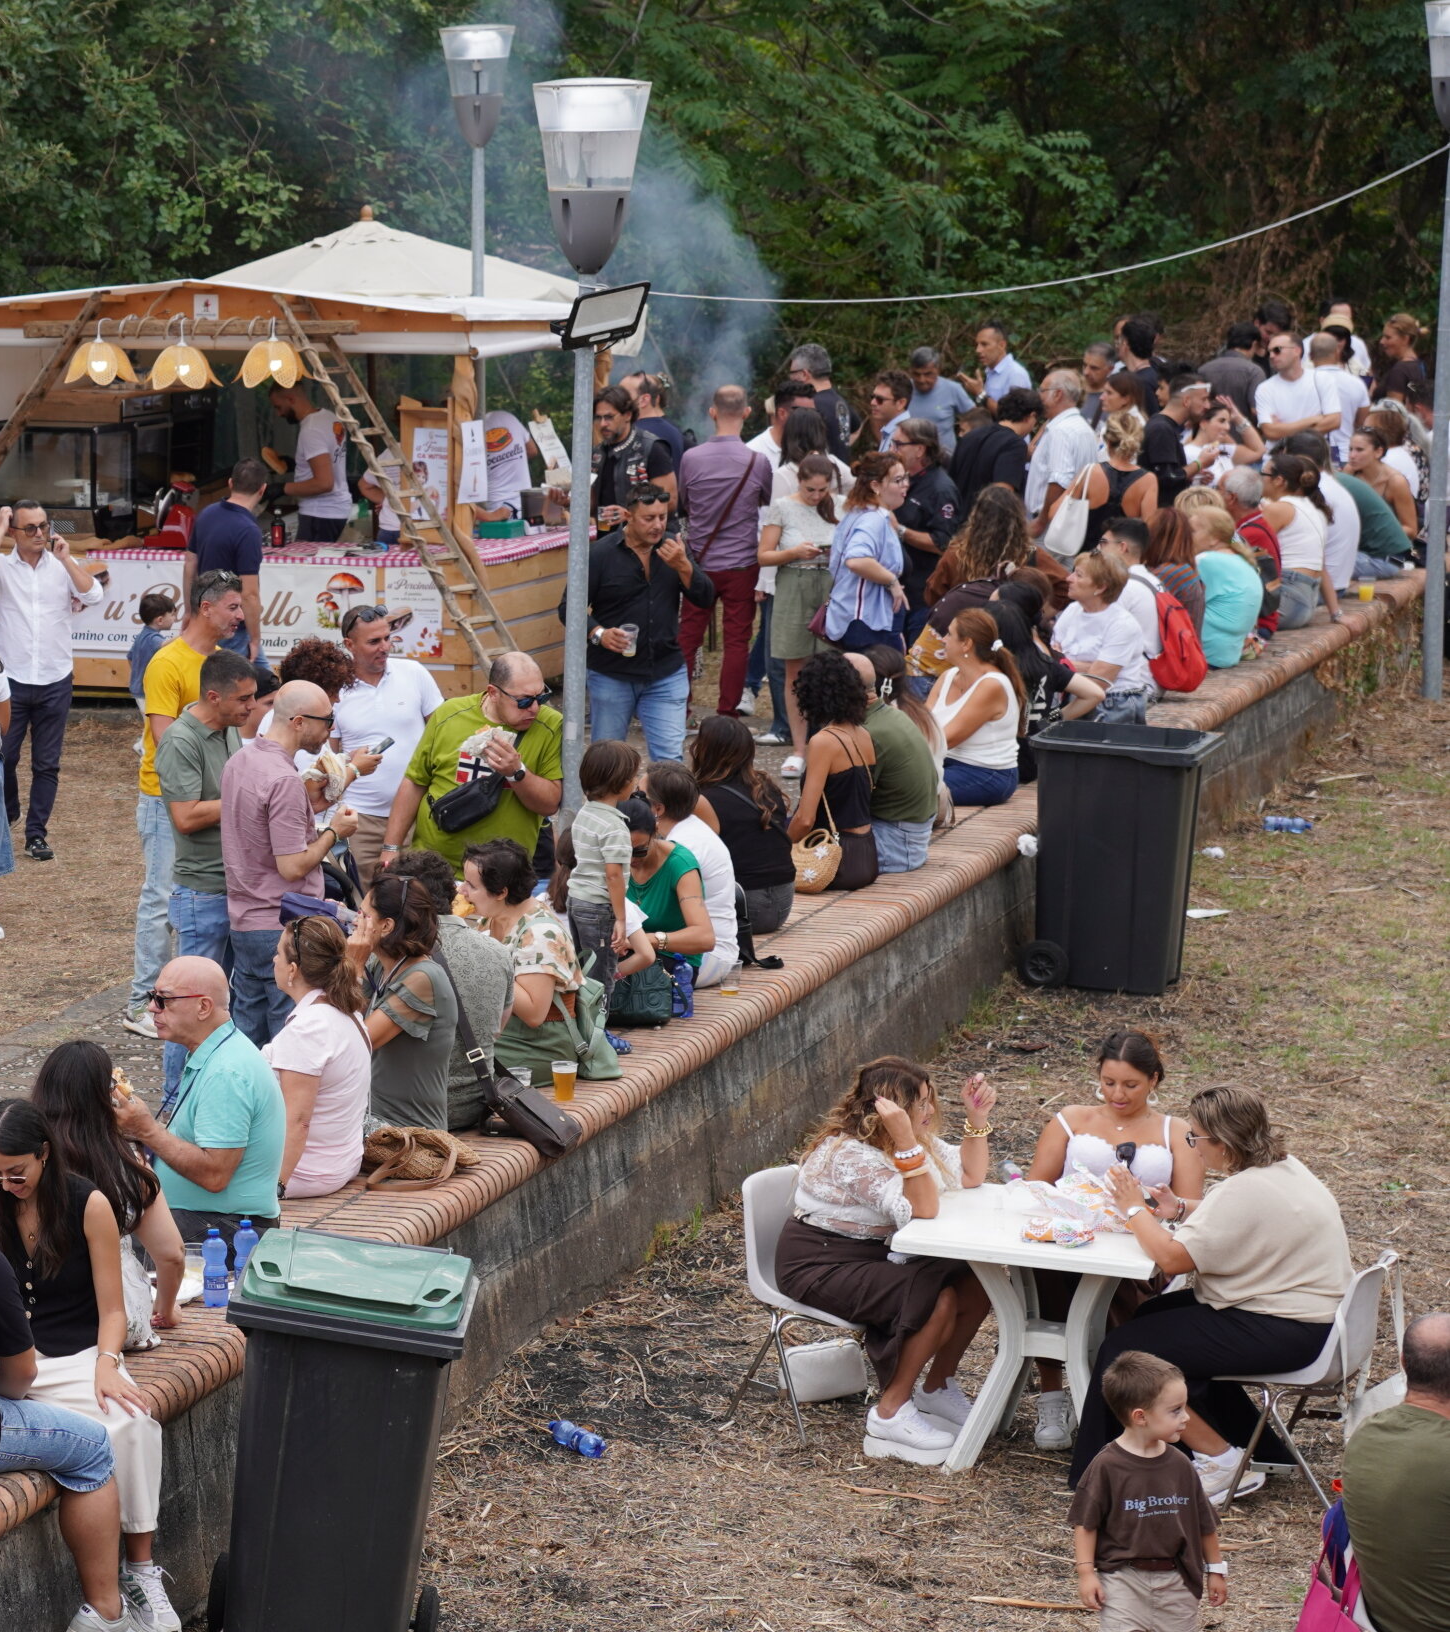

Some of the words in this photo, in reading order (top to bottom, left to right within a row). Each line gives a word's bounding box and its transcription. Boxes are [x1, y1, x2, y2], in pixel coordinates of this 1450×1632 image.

[487, 444, 524, 467] ocaccella
[71, 630, 104, 641] anino
[107, 633, 128, 642] con
[1124, 1498, 1147, 1513] Big
